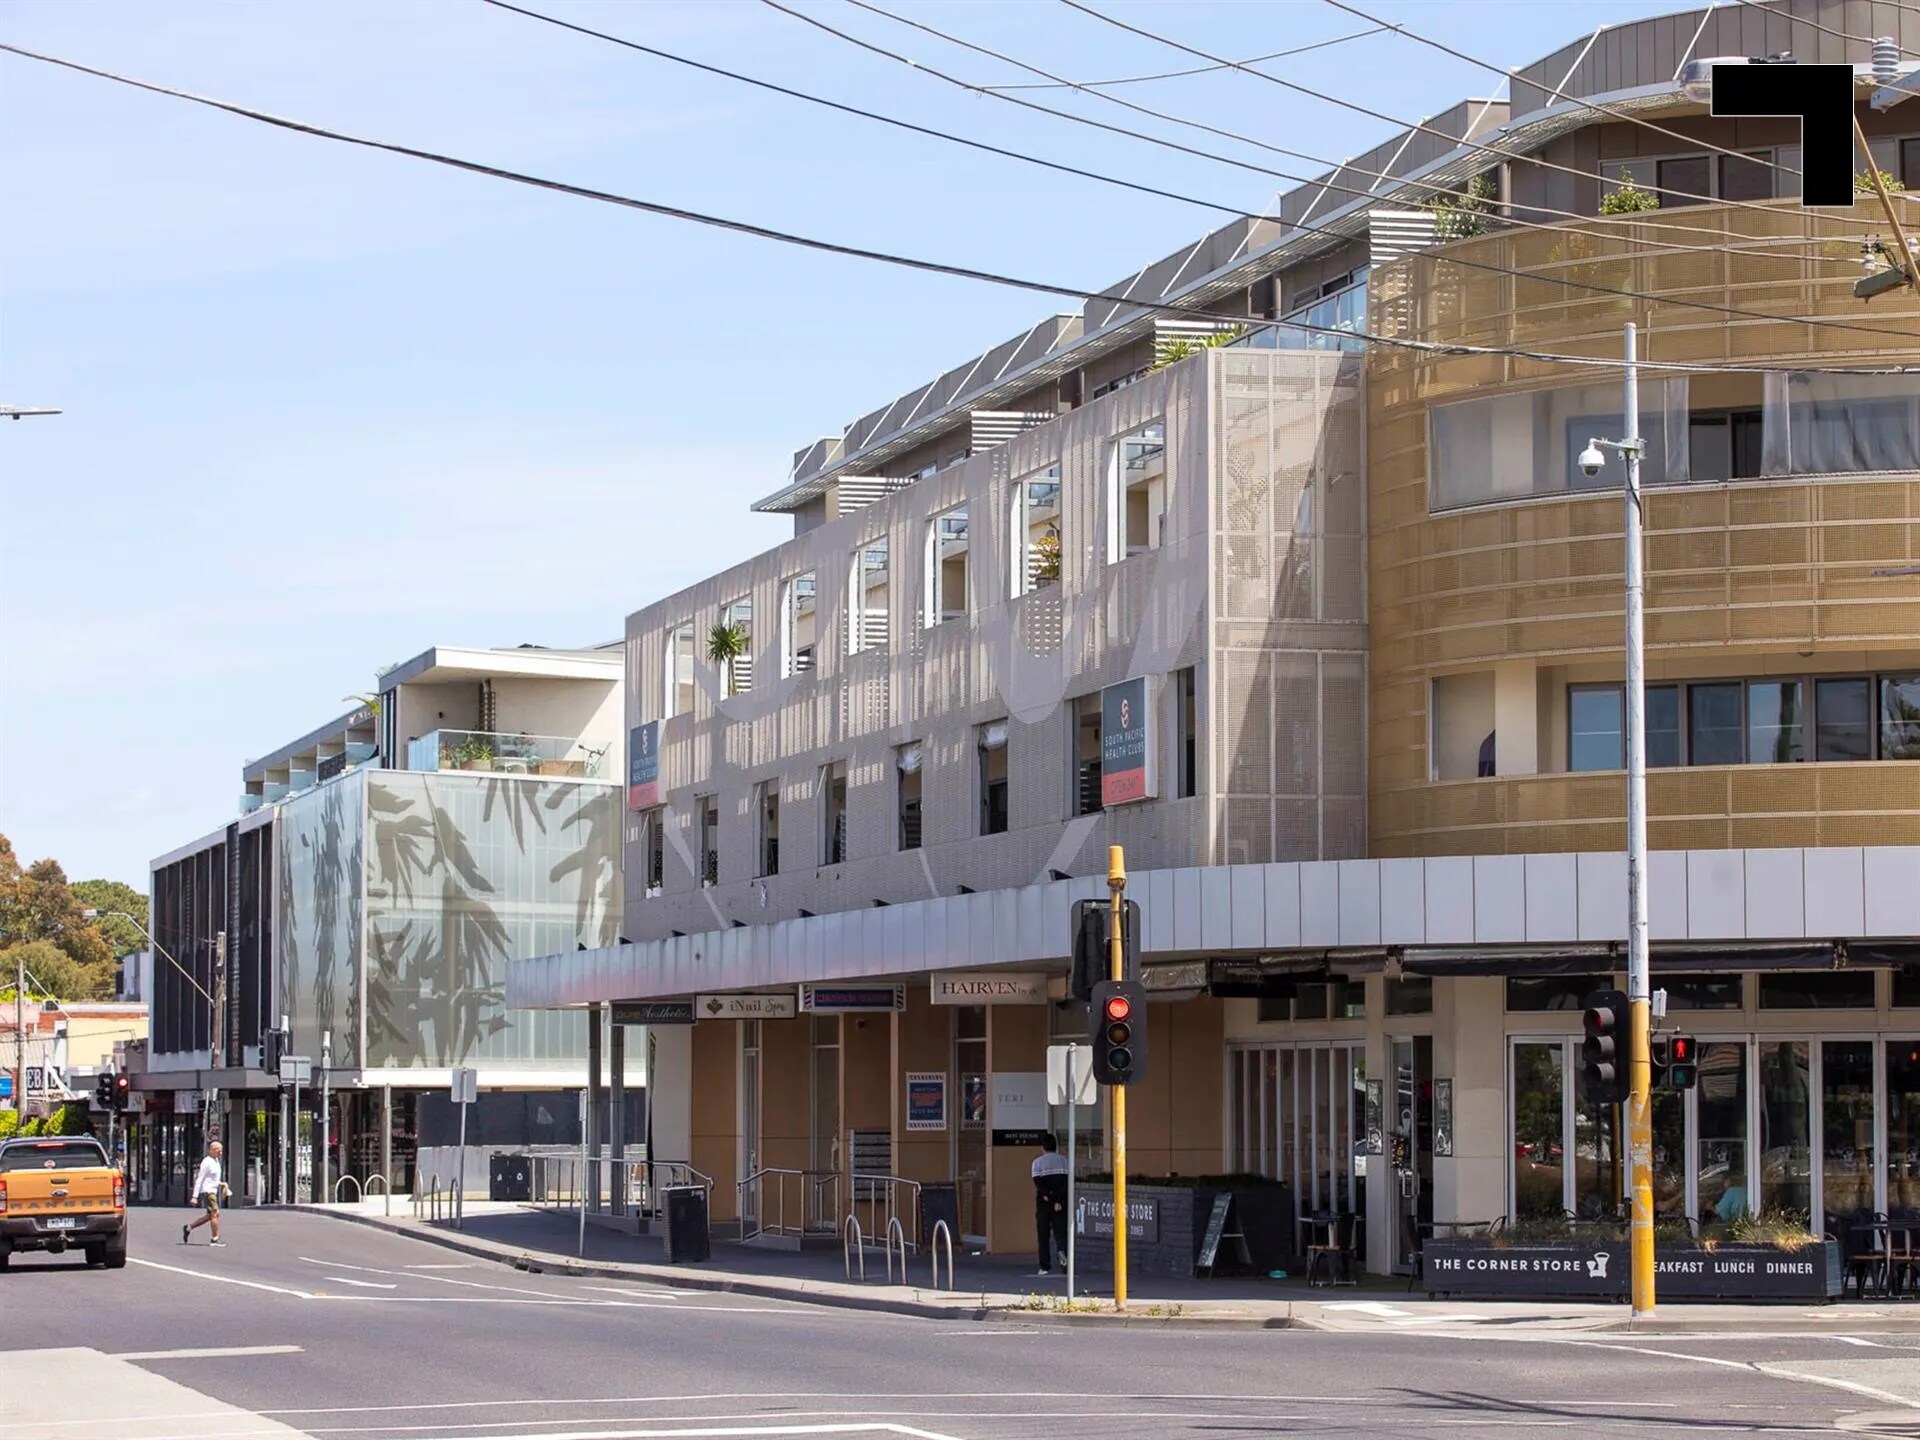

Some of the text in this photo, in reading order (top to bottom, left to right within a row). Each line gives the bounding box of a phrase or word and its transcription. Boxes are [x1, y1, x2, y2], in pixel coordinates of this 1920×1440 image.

[1104, 727, 1144, 747] SOUTH PACIFIC
[1104, 746, 1126, 760] HEALTH
[942, 981, 1017, 994] HAIRVEN
[730, 1000, 761, 1012] iNail
[1087, 1201, 1099, 1217] THE
[1131, 1204, 1153, 1220] STORE
[1434, 1258, 1581, 1272] THE CORNER STORE
[1653, 1261, 1813, 1274] EAKFAST LUNCH DINNER
